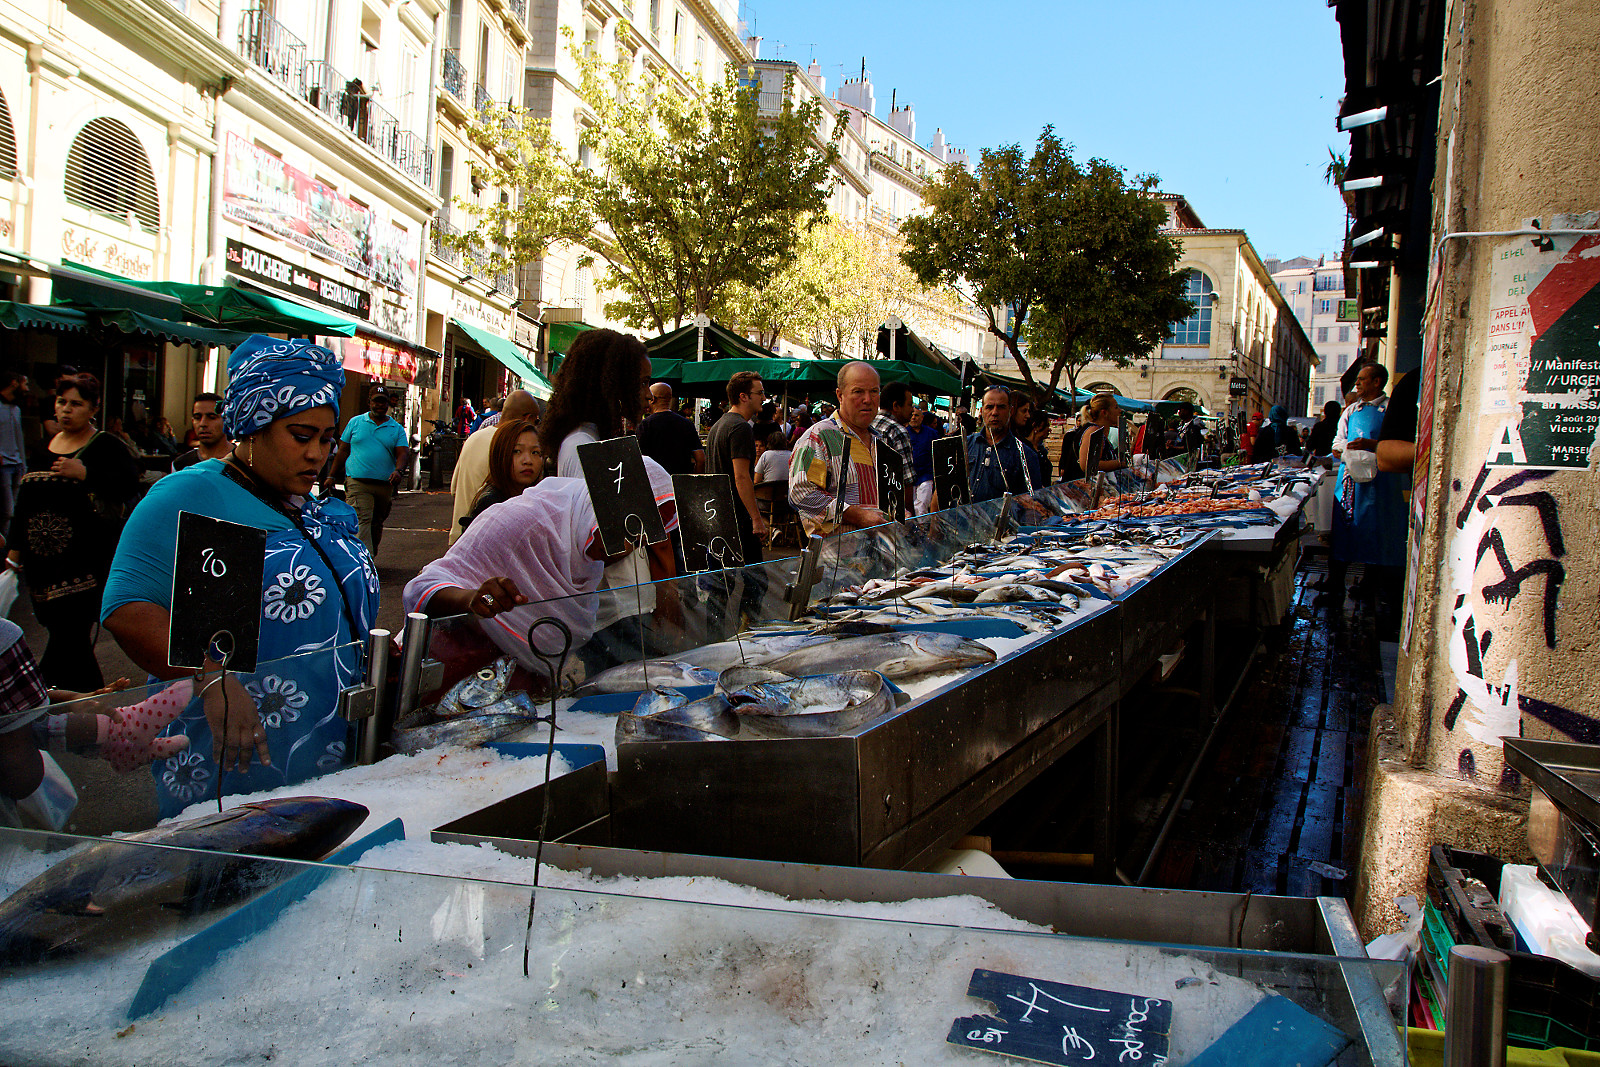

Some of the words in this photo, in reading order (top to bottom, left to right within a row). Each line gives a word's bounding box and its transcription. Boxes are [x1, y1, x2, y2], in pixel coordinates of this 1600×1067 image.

[62, 227, 98, 262] Café
[241, 247, 292, 285] BOUCHERIE
[320, 278, 360, 309] RESTAURANT
[456, 299, 500, 327] FANTASIA
[1495, 309, 1518, 320] APPEL
[1491, 323, 1510, 333] DANS
[1555, 415, 1561, 423] 2
[1562, 415, 1584, 423] août
[608, 461, 626, 494] 7
[704, 498, 717, 522] 5
[1062, 1025, 1096, 1060] €
